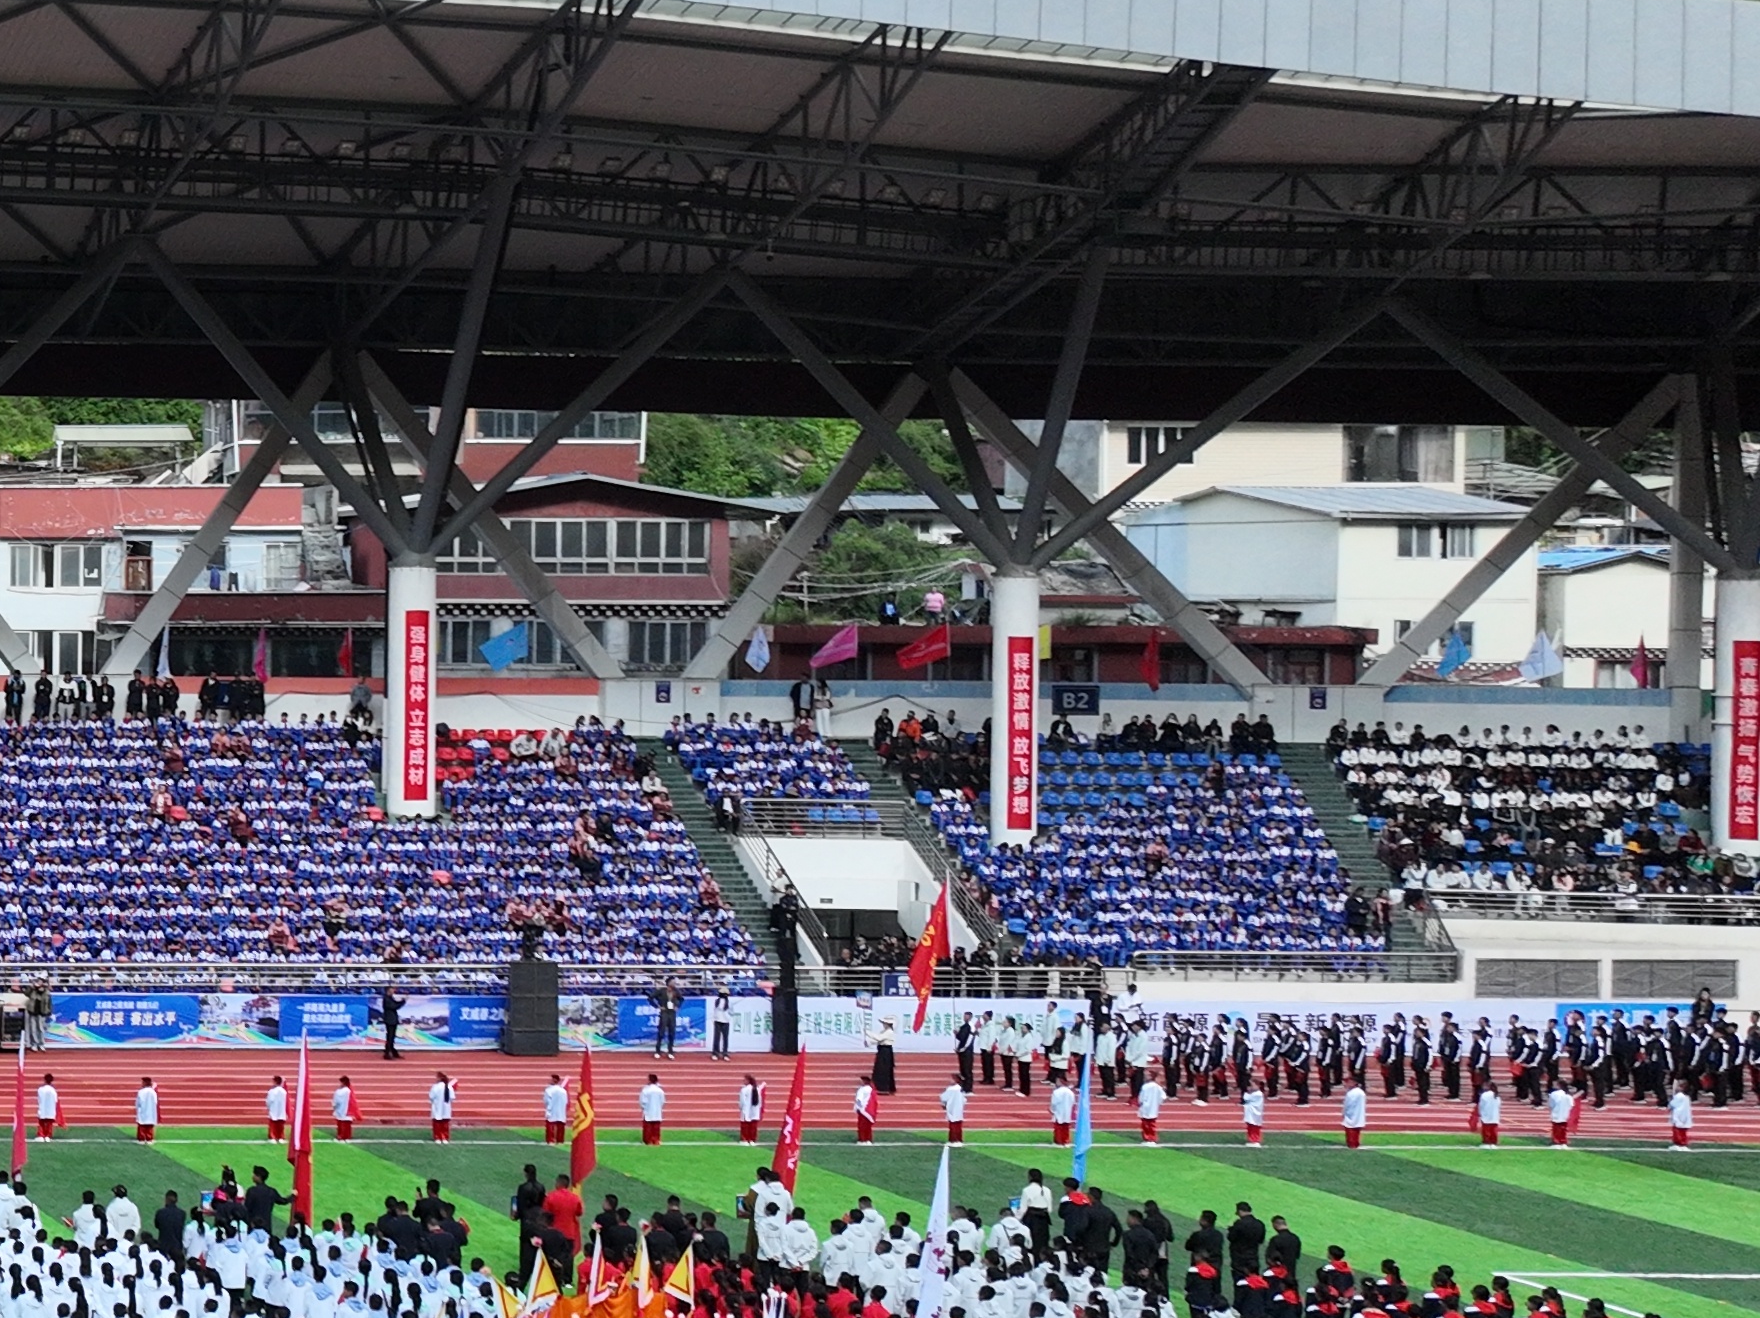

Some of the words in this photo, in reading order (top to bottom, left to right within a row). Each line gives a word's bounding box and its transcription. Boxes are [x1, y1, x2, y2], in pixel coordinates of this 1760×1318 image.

[409, 626, 426, 702] 强身健体
[1013, 653, 1030, 731] 释放激情
[1062, 692, 1089, 708] B2
[1738, 657, 1758, 738] 青春激扬
[408, 709, 425, 786] 立志成材
[1012, 736, 1030, 815] 放飞梦想
